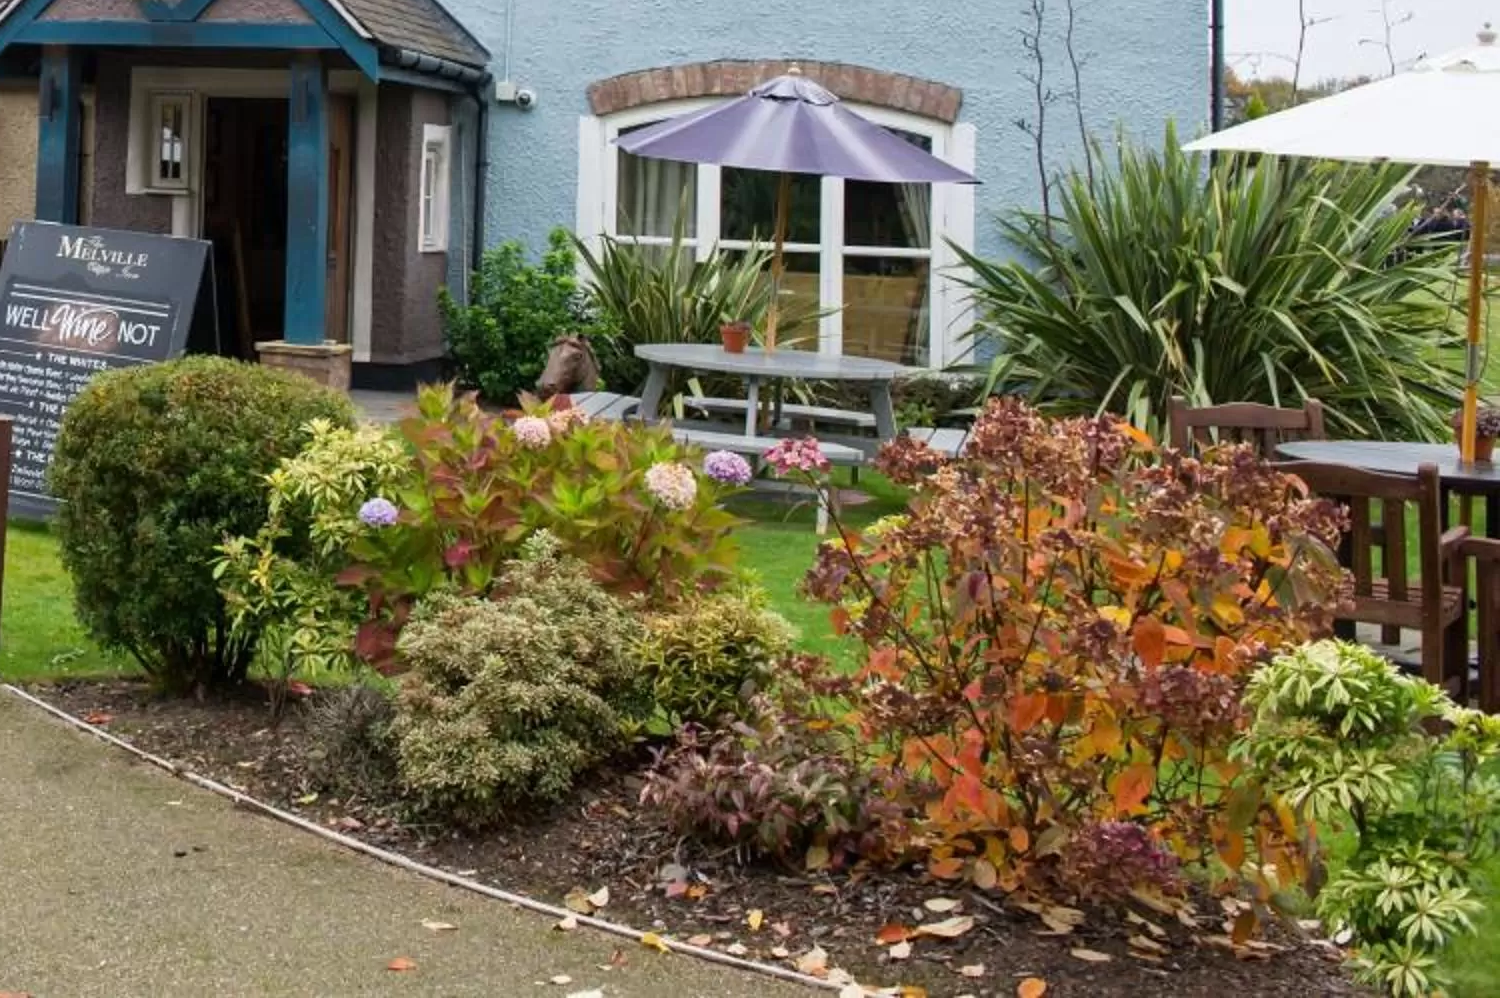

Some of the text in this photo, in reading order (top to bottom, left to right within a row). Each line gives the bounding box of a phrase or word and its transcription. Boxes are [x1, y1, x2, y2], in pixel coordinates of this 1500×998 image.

[56, 235, 148, 267] MELVILLE
[5, 303, 161, 347] WELL Wine NOT
[47, 352, 68, 365] THE
